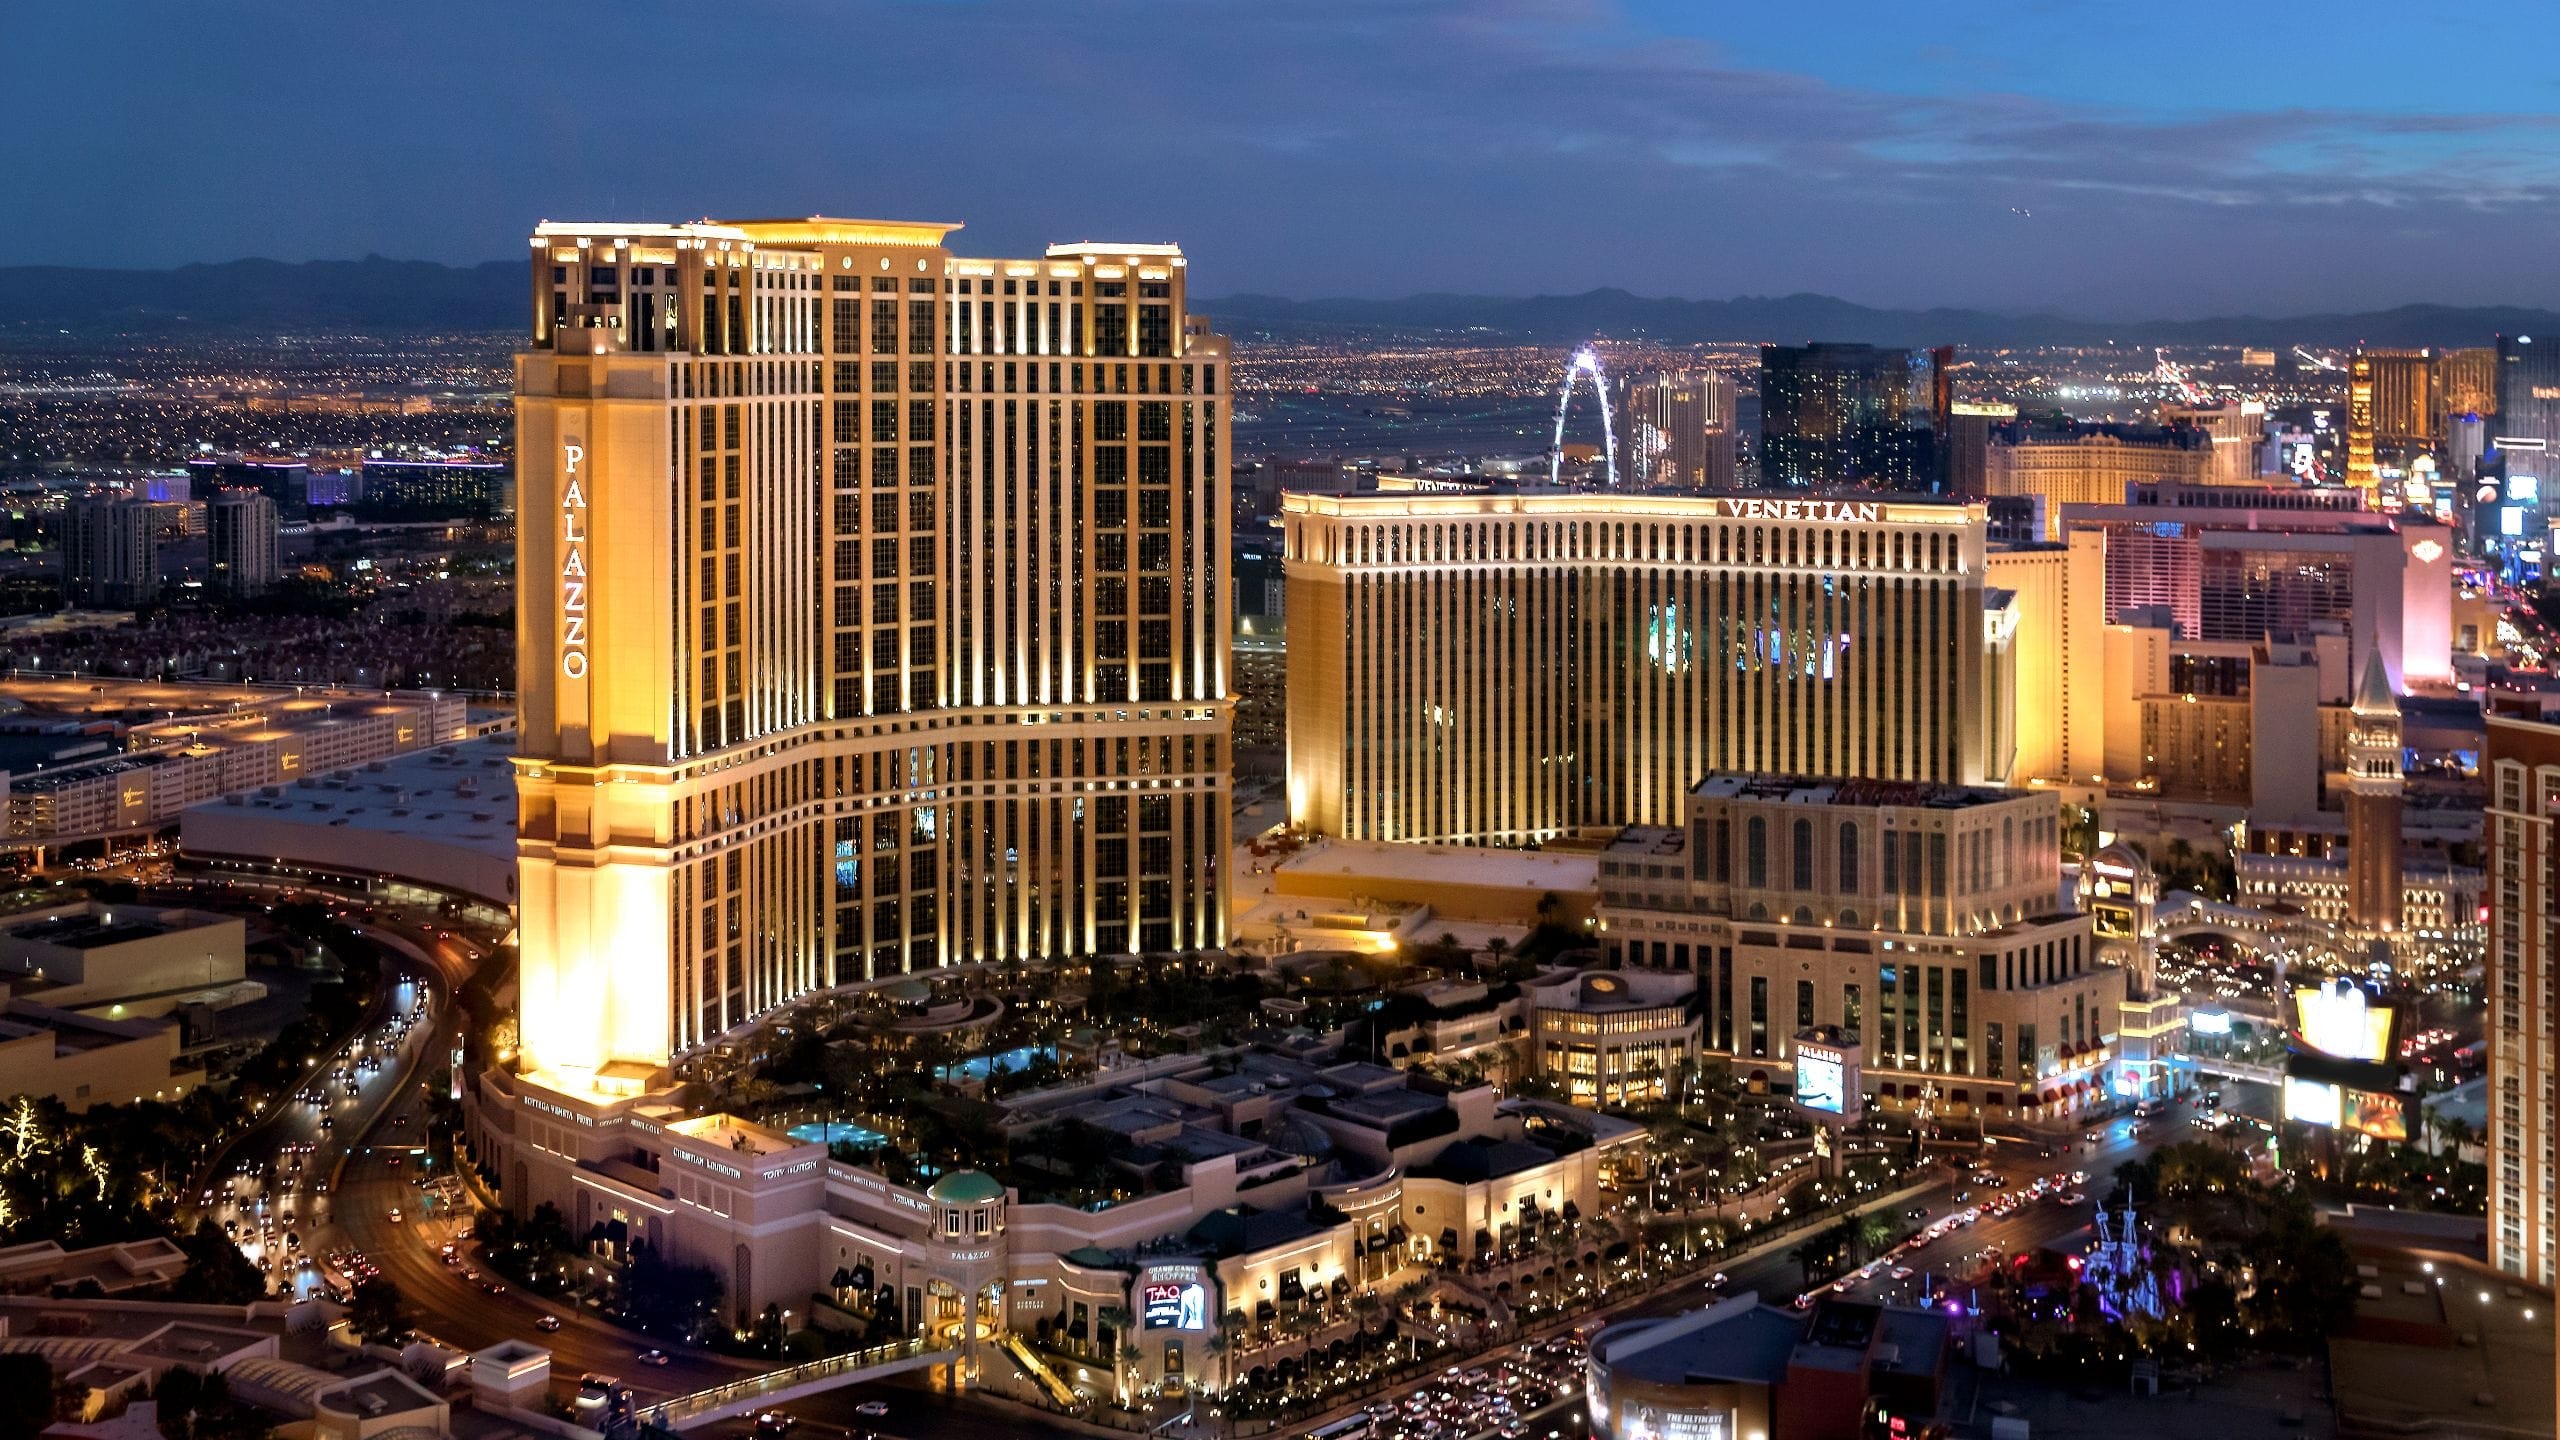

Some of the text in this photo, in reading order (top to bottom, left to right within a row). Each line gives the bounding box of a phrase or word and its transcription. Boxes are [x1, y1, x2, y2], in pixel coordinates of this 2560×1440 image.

[1724, 498, 1880, 523] VENETIAN
[562, 445, 588, 679] PALAZZO
[1797, 1044, 1842, 1063] PALAZZO
[673, 1147, 704, 1167] CHRISTIAN
[763, 1169, 785, 1181] TORY
[951, 1250, 990, 1261] PALAZZO
[1148, 1264, 1199, 1274] GRAND CANAL
[1145, 1285, 1180, 1302] TAO
[1666, 1412, 1724, 1424] THE ULTIMATE
